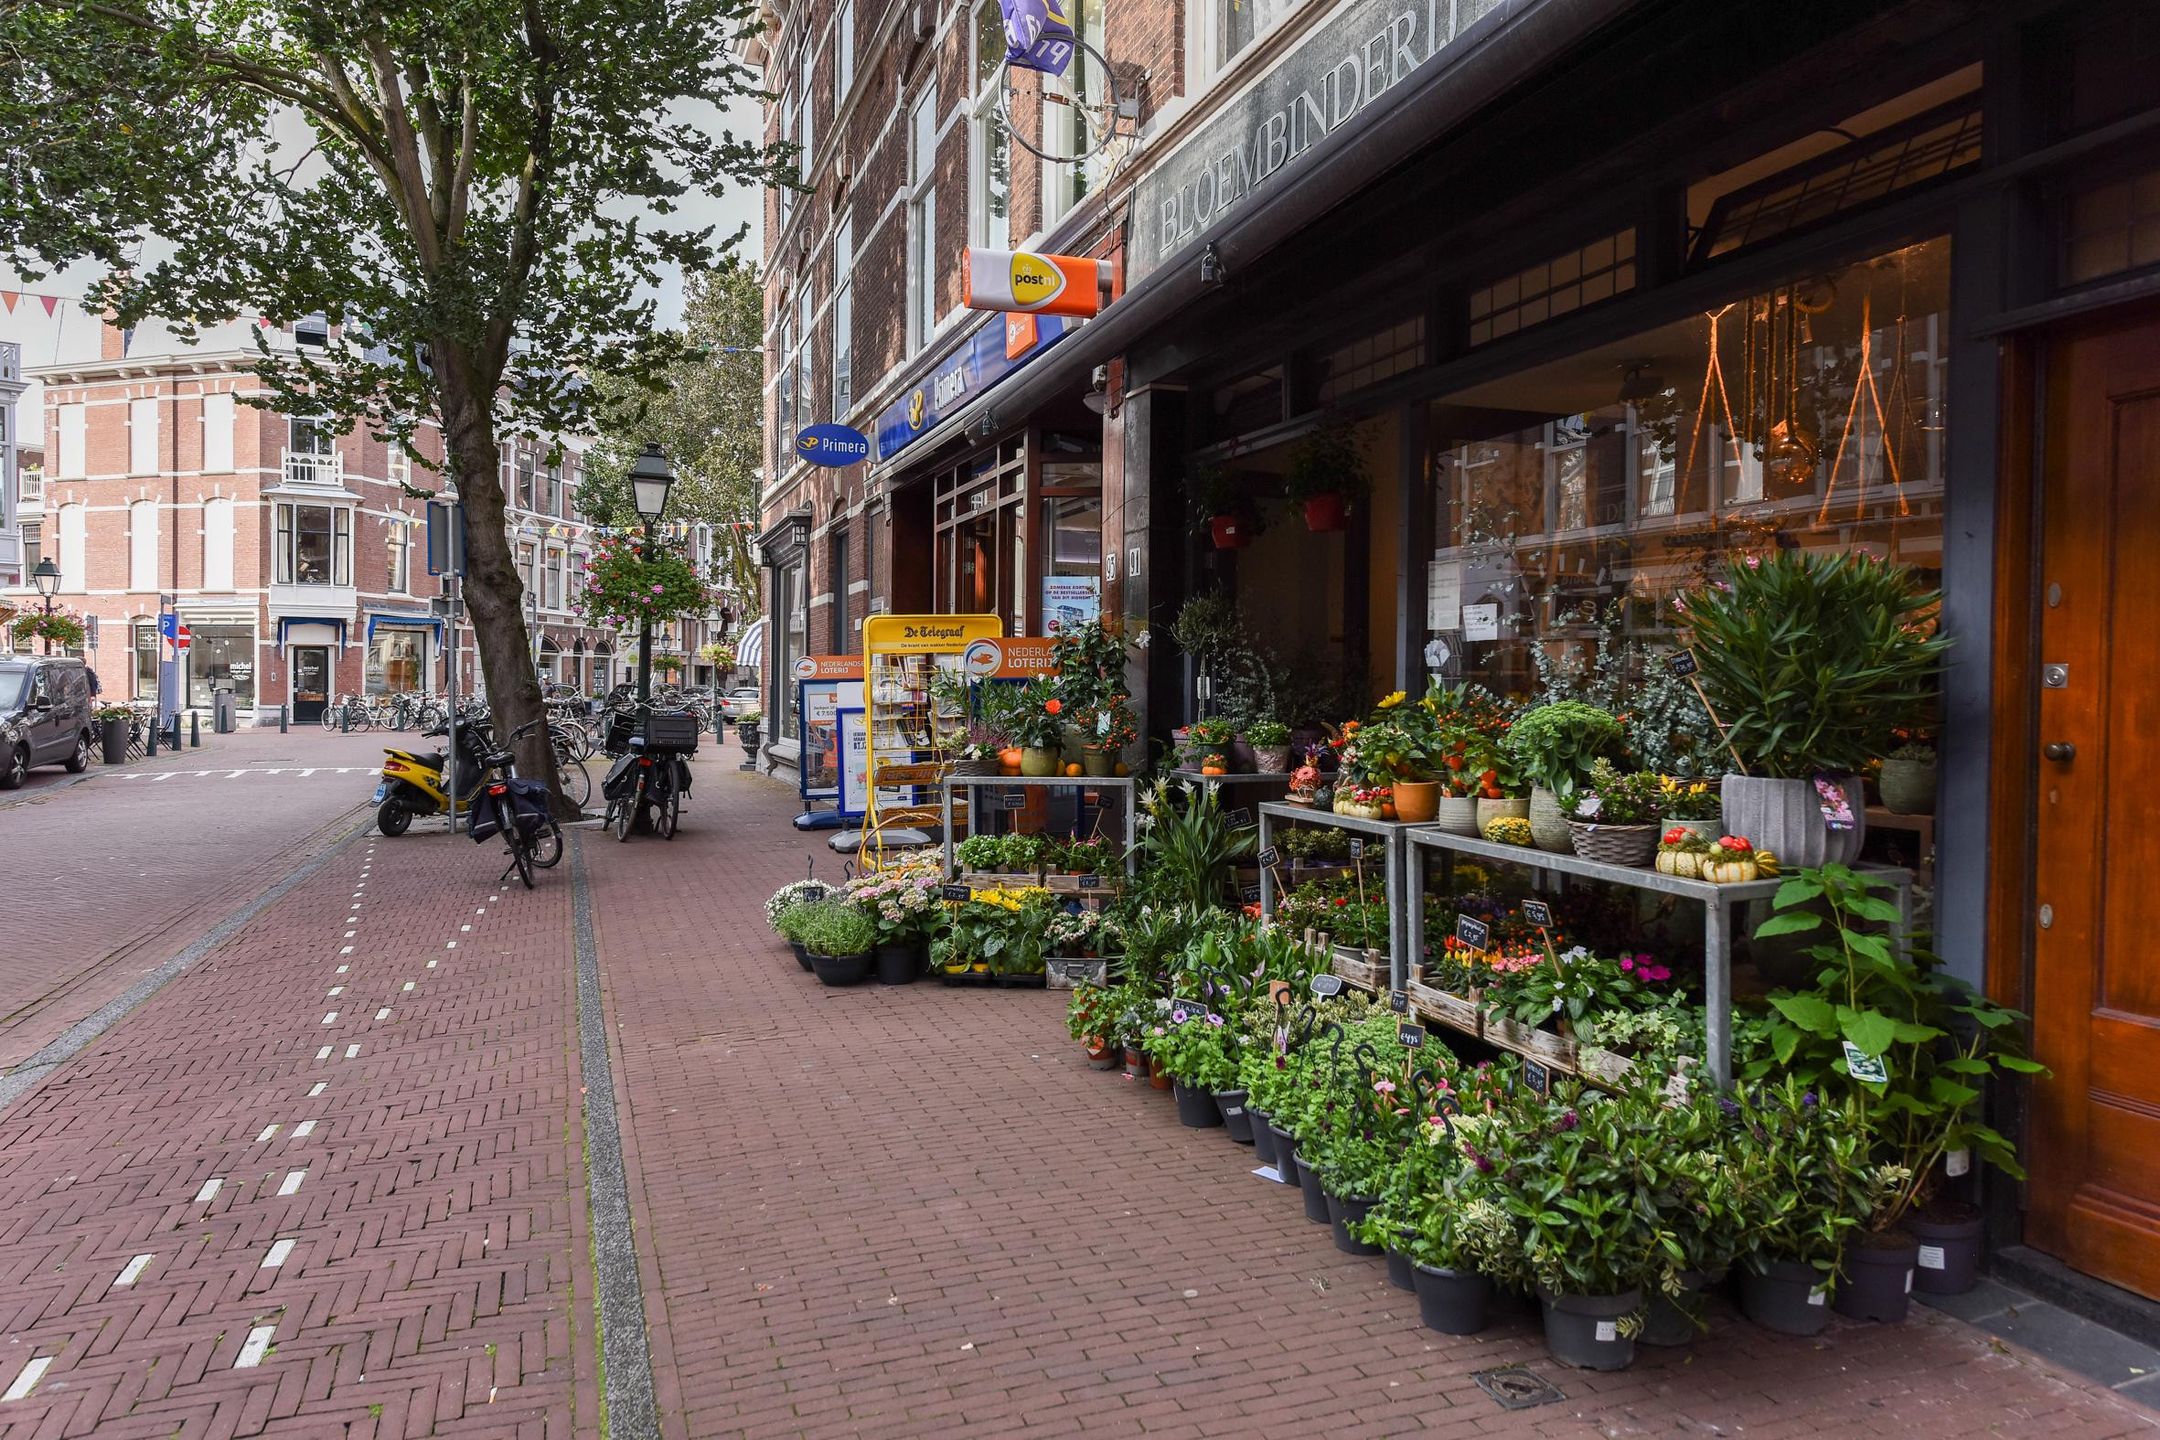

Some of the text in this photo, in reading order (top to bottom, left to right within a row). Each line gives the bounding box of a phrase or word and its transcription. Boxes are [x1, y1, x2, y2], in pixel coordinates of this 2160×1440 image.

[1015, 273, 1055, 287] postnl
[823, 438, 866, 454] Primera
[1107, 556, 1115, 580] 93
[1131, 551, 1139, 575] 91
[904, 624, 965, 639] De Telegraaf
[229, 662, 252, 670] michel
[820, 666, 849, 674] LOTERIJ
[1008, 658, 1053, 668] LOTERIJ
